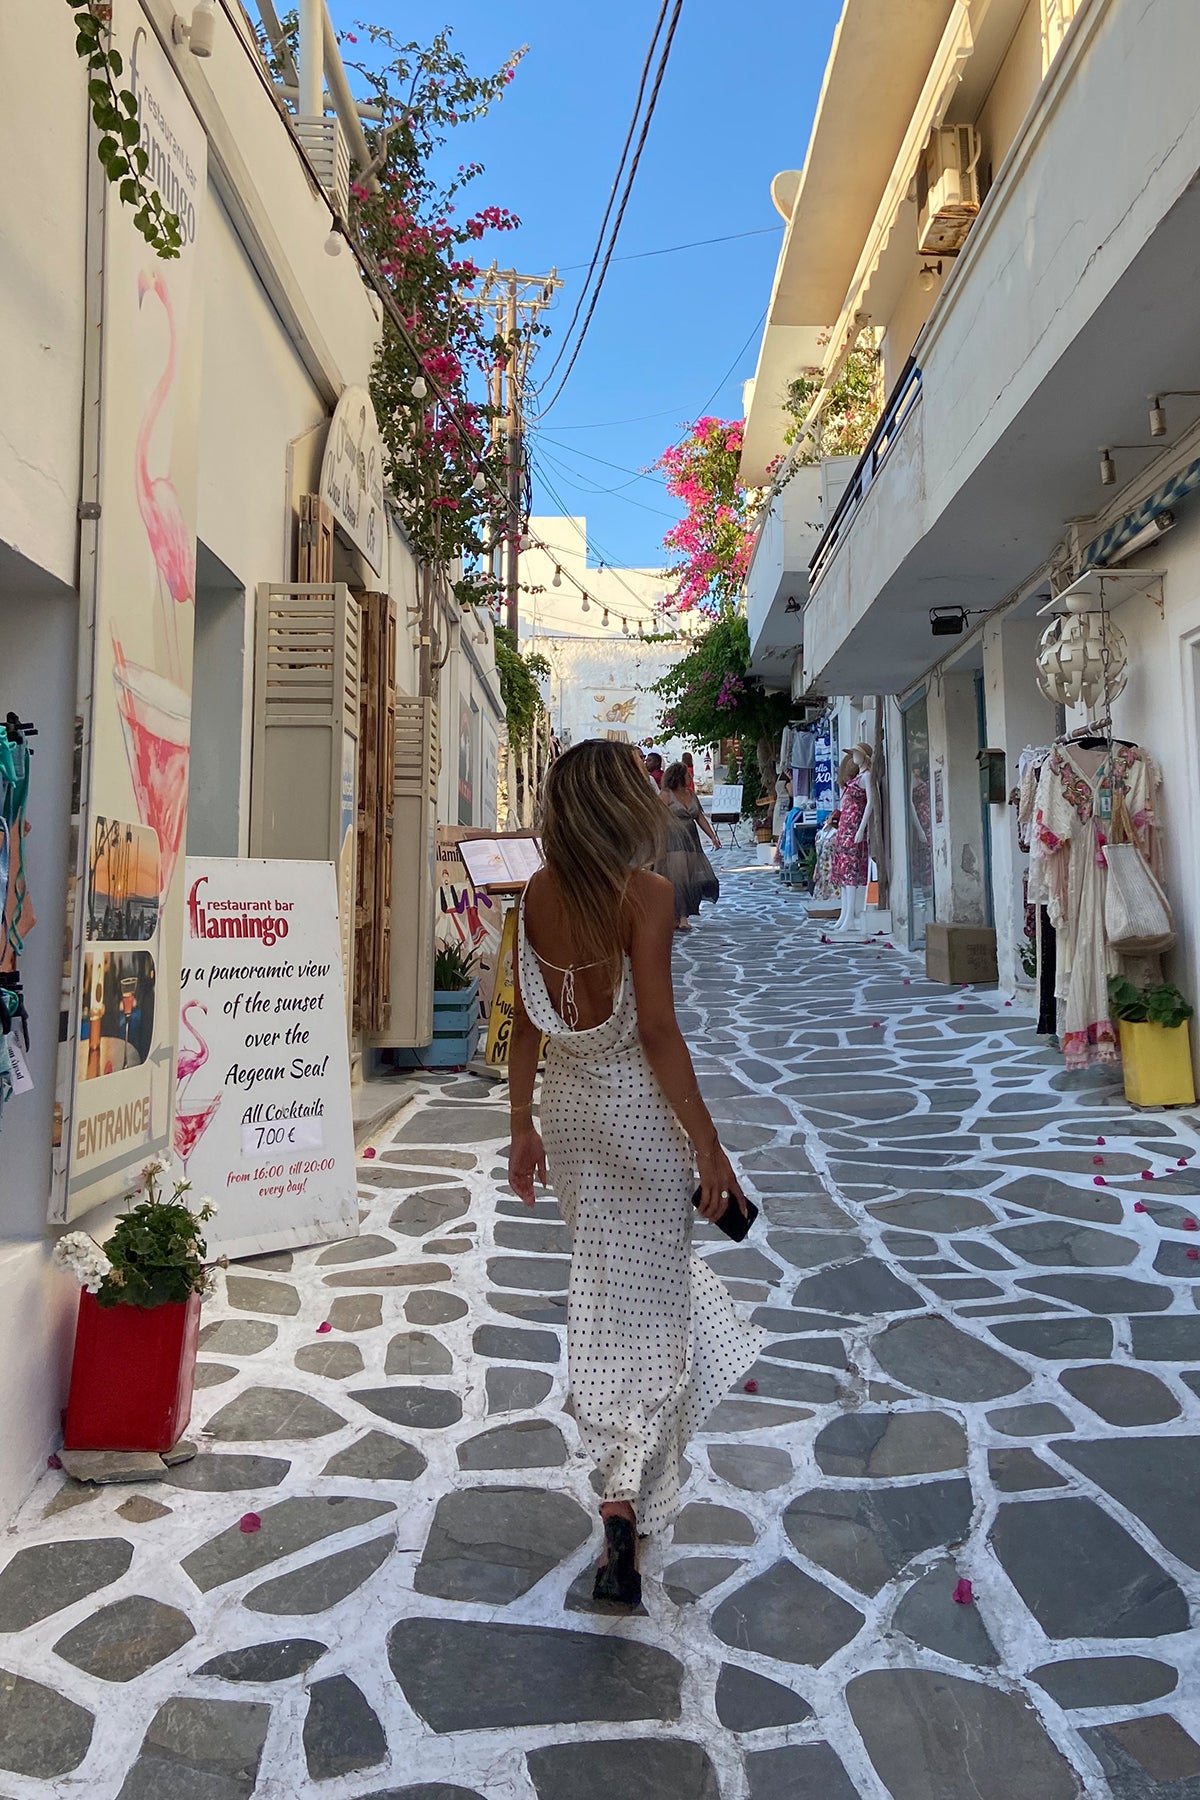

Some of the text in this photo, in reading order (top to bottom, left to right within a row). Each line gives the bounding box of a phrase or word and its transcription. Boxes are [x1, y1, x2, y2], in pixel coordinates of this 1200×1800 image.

[144, 85, 197, 190] restaurant bar
[187, 876, 290, 947] flamingo
[207, 899, 295, 911] restaurant bar
[194, 968, 205, 981] a
[208, 961, 294, 988] panoramic
[298, 960, 331, 978] view
[223, 991, 325, 1020] of the sunset
[245, 1022, 310, 1048] over the
[224, 1055, 330, 1091] Aegean Sea!
[241, 1098, 325, 1125] All Cocktails
[76, 1096, 150, 1160] ENTRANCE
[288, 1126, 296, 1144] €
[226, 1157, 336, 1187] from 16:00 till 20:00
[258, 1177, 308, 1199] every day!
